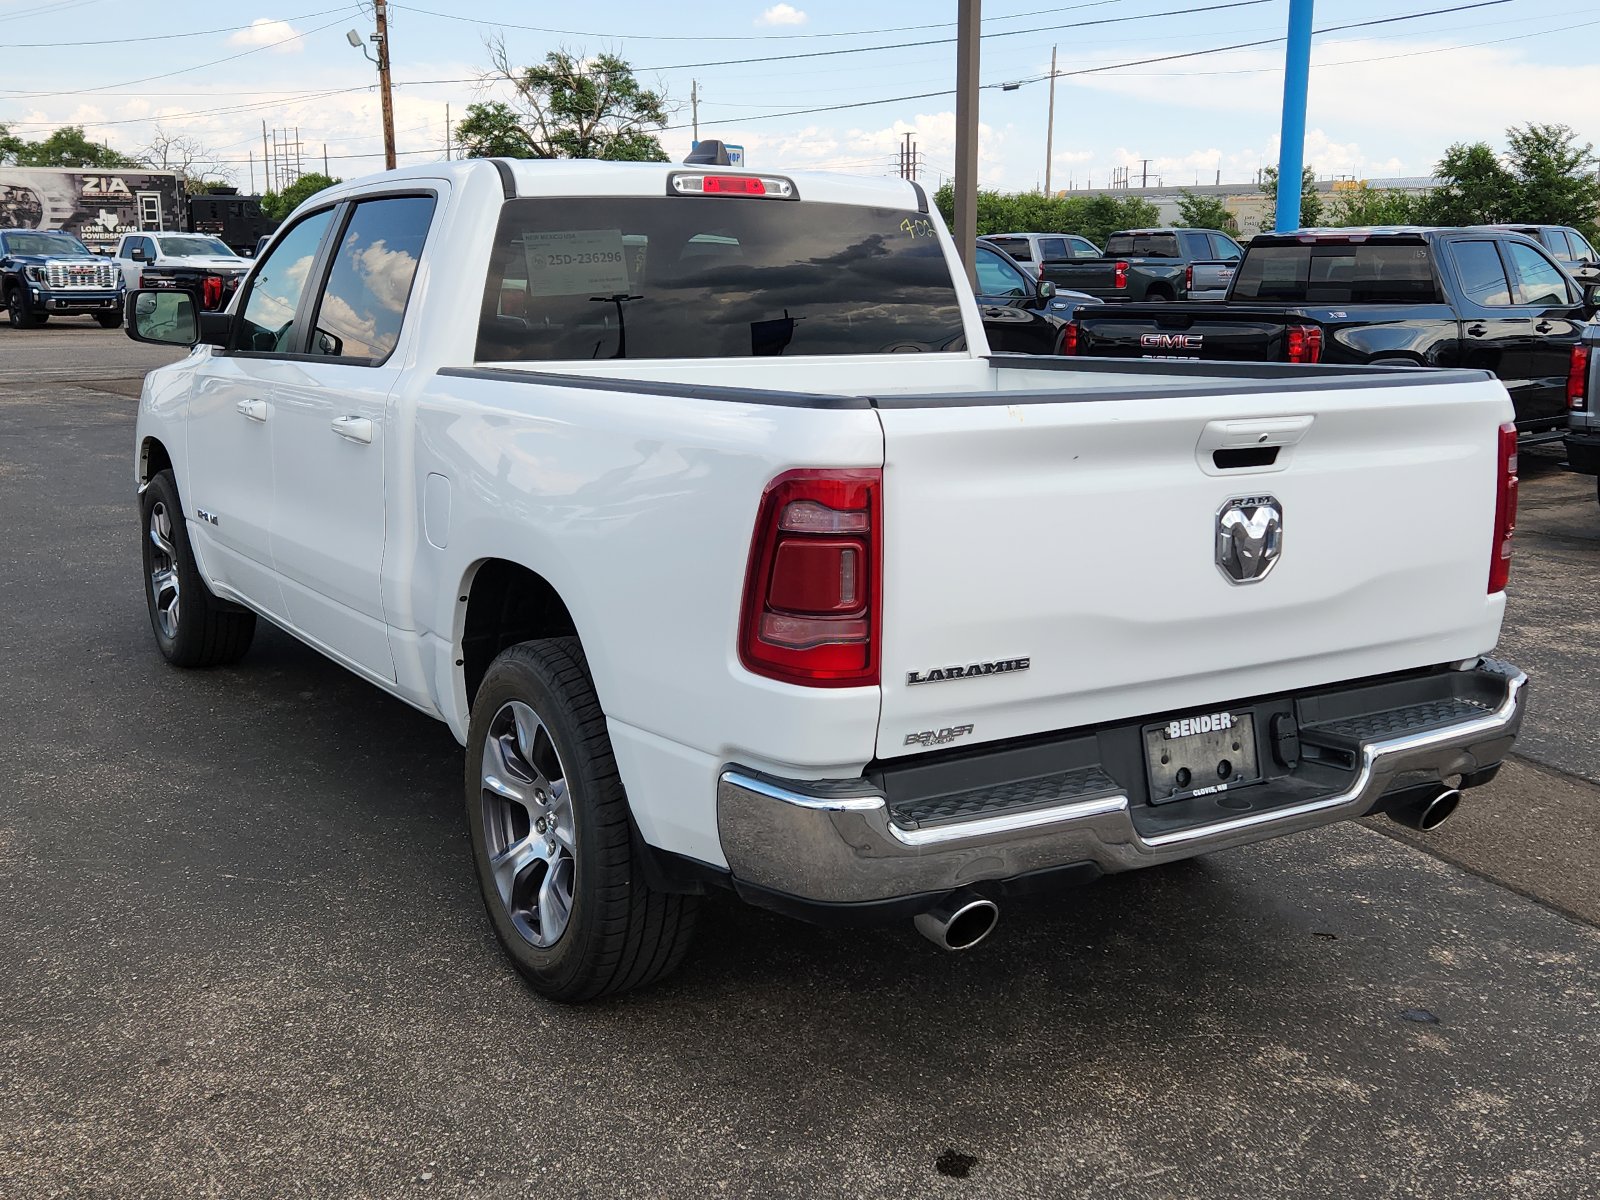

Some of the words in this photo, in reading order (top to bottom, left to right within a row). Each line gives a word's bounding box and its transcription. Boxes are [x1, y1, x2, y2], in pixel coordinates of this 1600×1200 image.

[727, 152, 741, 163] HOP
[82, 177, 130, 193] ZIA
[81, 225, 104, 233] LONE
[116, 225, 138, 233] STAR
[547, 251, 622, 266] 25D-236296
[1141, 334, 1203, 349] GMC
[1230, 497, 1271, 508] RAM
[906, 656, 1030, 686] LARAMIE
[1169, 712, 1232, 739] BENDER
[903, 723, 975, 746] BENDER
[1192, 784, 1218, 797] CLOVIS,
[1217, 783, 1228, 792] NM
